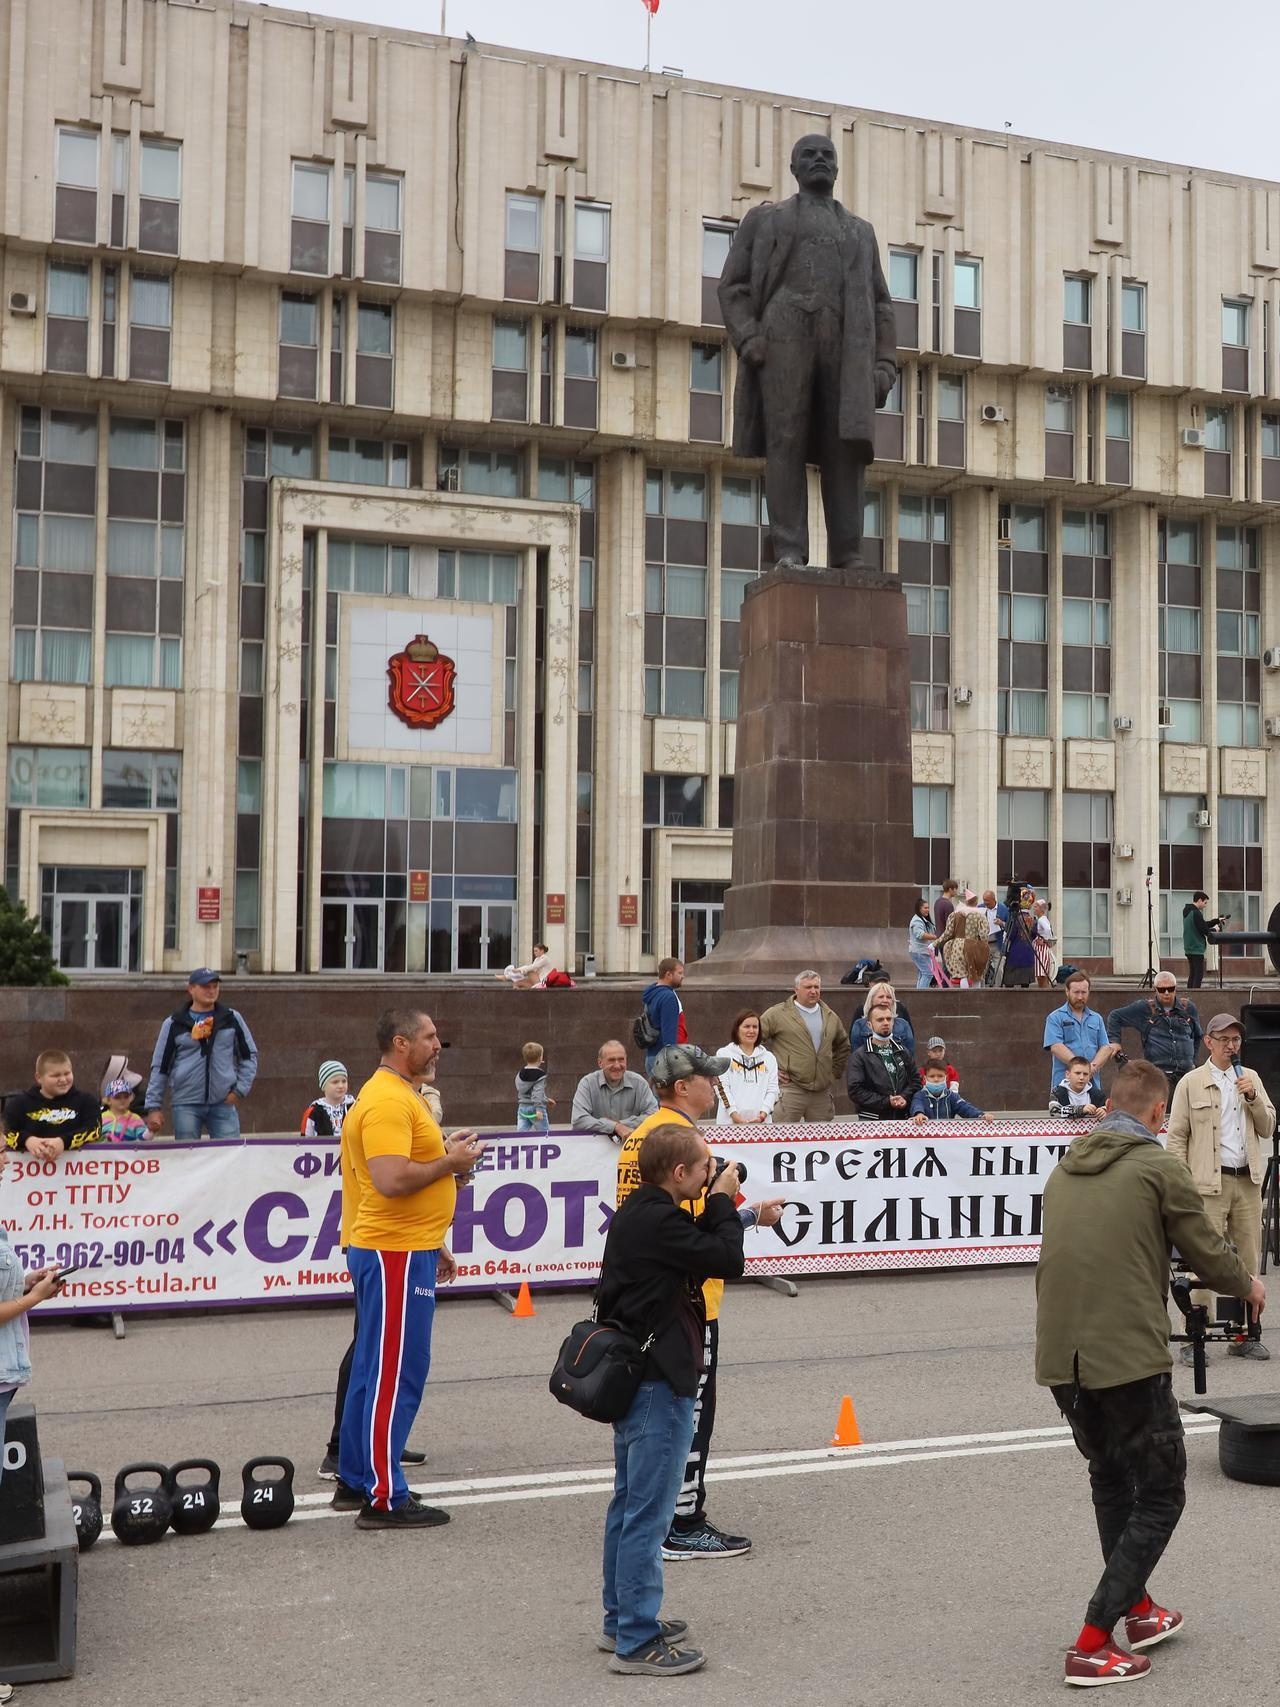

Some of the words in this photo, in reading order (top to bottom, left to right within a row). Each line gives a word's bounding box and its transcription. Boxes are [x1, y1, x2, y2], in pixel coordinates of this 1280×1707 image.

[477, 1144, 562, 1171] ЕНТР
[64, 1159, 160, 1181] метров
[27, 1190, 58, 1206] от
[65, 1183, 132, 1205] ТГПУ
[29, 1214, 74, 1232] Л.Н.
[81, 1213, 179, 1229] Толстого
[60, 1272, 217, 1298] tness-tula.ru
[263, 1275, 291, 1290] ул.
[298, 1270, 353, 1286] Нико
[535, 1262, 564, 1273] вход
[566, 1262, 572, 1271] с
[573, 1260, 602, 1271] торц
[131, 1498, 153, 1515] 32
[183, 1492, 205, 1509] 24
[253, 1487, 273, 1504] 24
